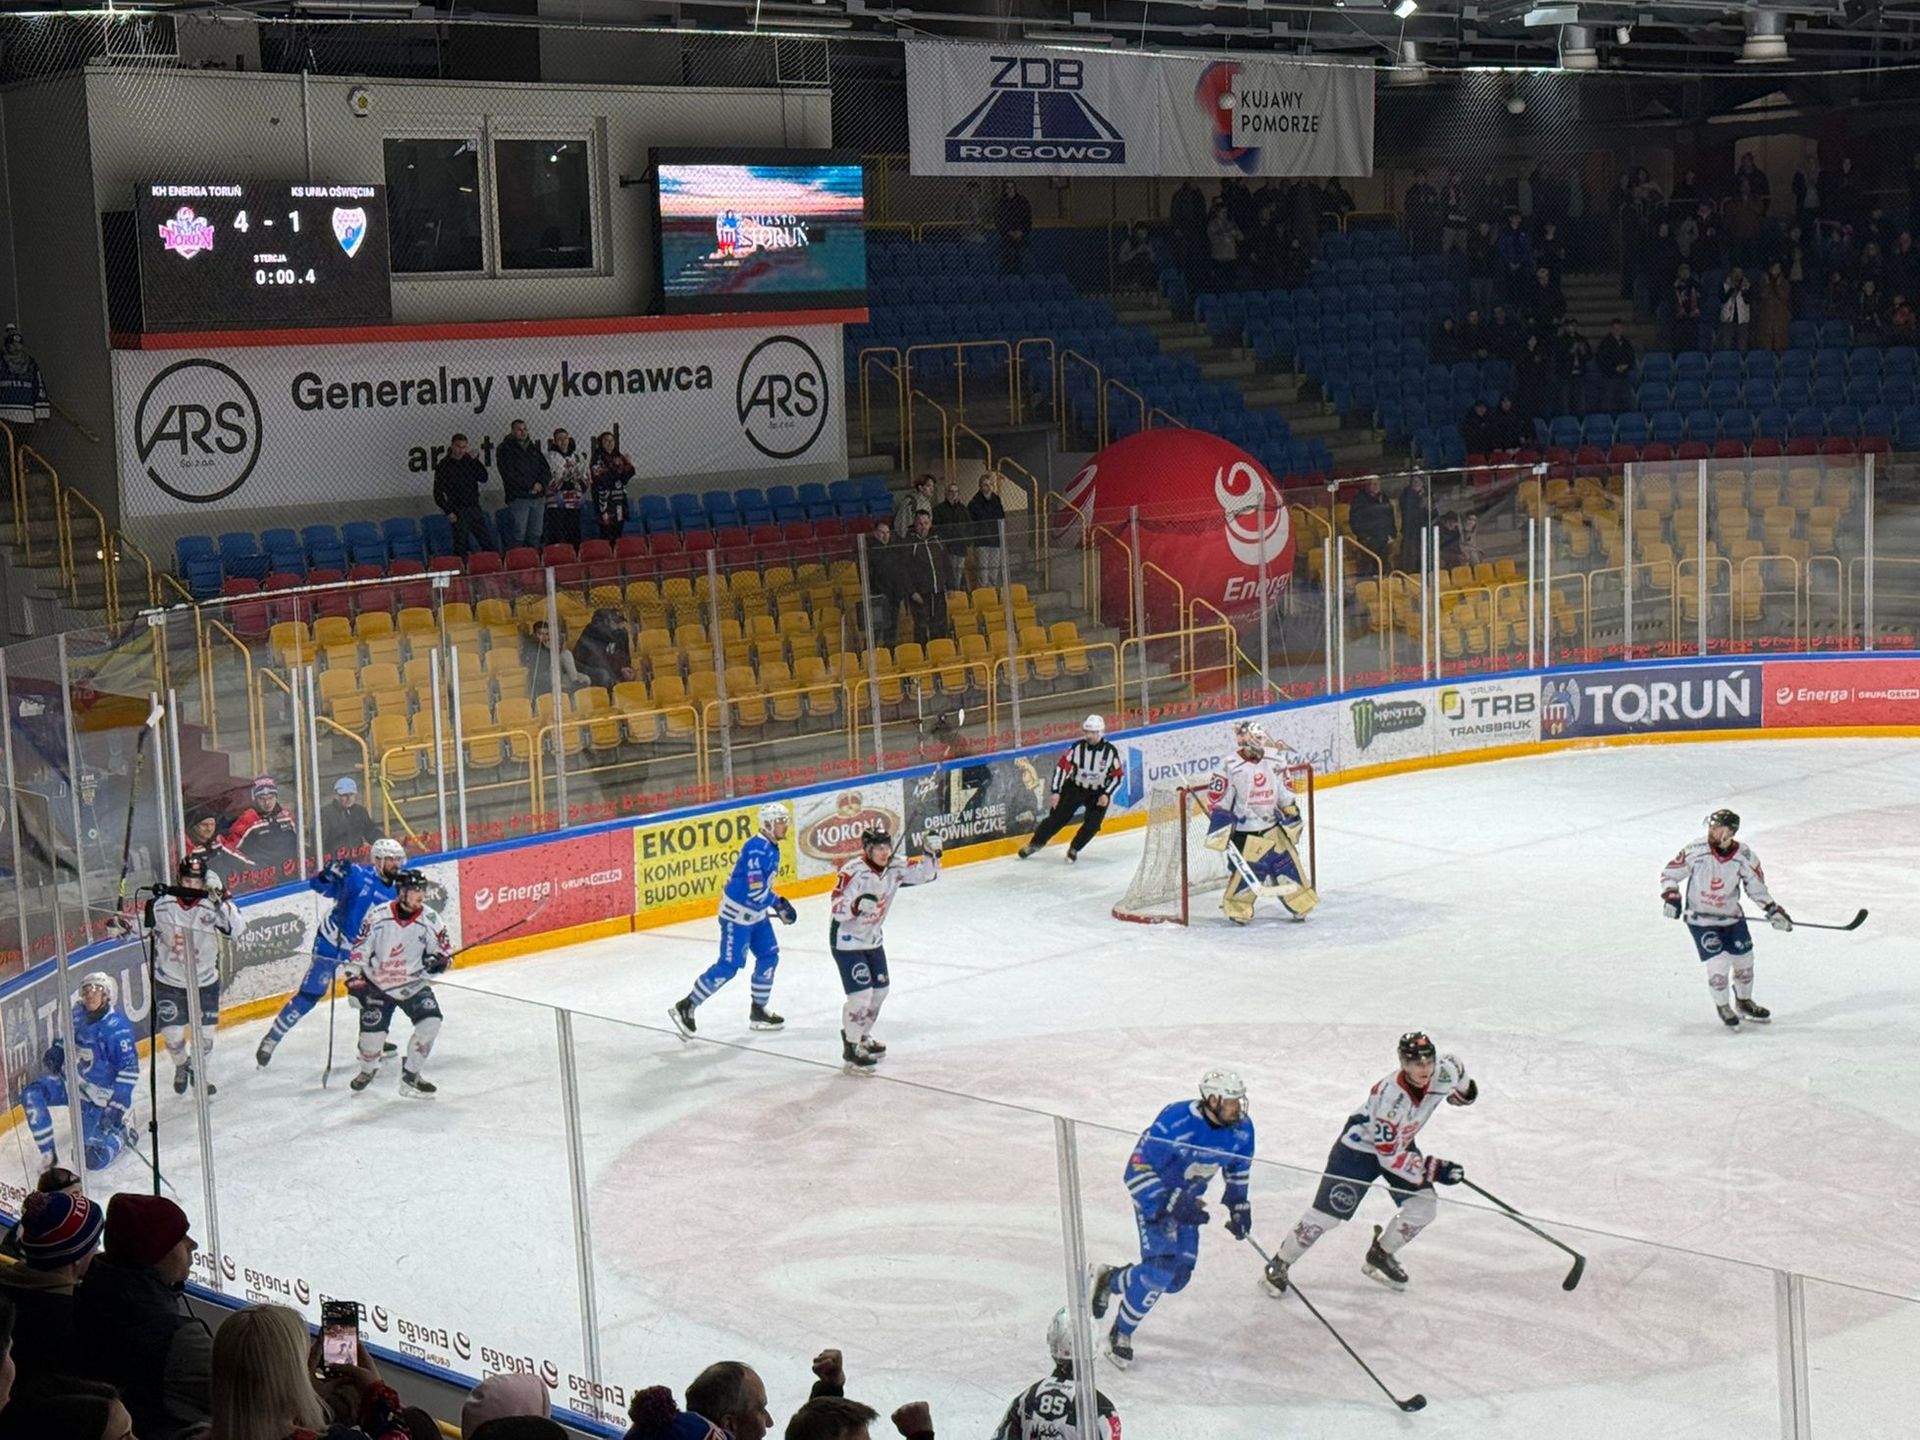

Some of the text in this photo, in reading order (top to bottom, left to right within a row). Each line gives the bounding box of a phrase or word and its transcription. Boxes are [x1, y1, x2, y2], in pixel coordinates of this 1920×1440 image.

[990, 55, 1084, 90] ZDB
[1240, 90, 1303, 109] KUJAWY
[1241, 115, 1319, 134] POMORZE
[959, 145, 1112, 161] ROGOWO
[152, 186, 167, 197] KH
[168, 186, 208, 197] ENERGA
[291, 187, 304, 197] KS
[305, 187, 328, 197] UNIA
[233, 210, 250, 233] 4
[288, 210, 300, 233] 1
[291, 361, 713, 414] Generalny wykonawca
[748, 371, 818, 419] ARS
[147, 401, 248, 455] ARS
[1471, 693, 1535, 718] TRB
[1585, 670, 1751, 724] TORUŃ
[1797, 688, 1848, 704] Energa
[1375, 705, 1423, 722] MONSTER
[1450, 720, 1531, 737] TRANSBRUK
[962, 810, 973, 822] W
[975, 802, 1006, 818] SOBIE
[643, 815, 753, 859] EKOTOR
[911, 817, 1007, 847] WOWNICZKĘ
[644, 850, 740, 884] KOMPLEKSO
[498, 882, 550, 904] Energa
[561, 877, 590, 890] GRUPA
[645, 875, 717, 905] BUDOWY
[1040, 1394, 1067, 1416] 85
